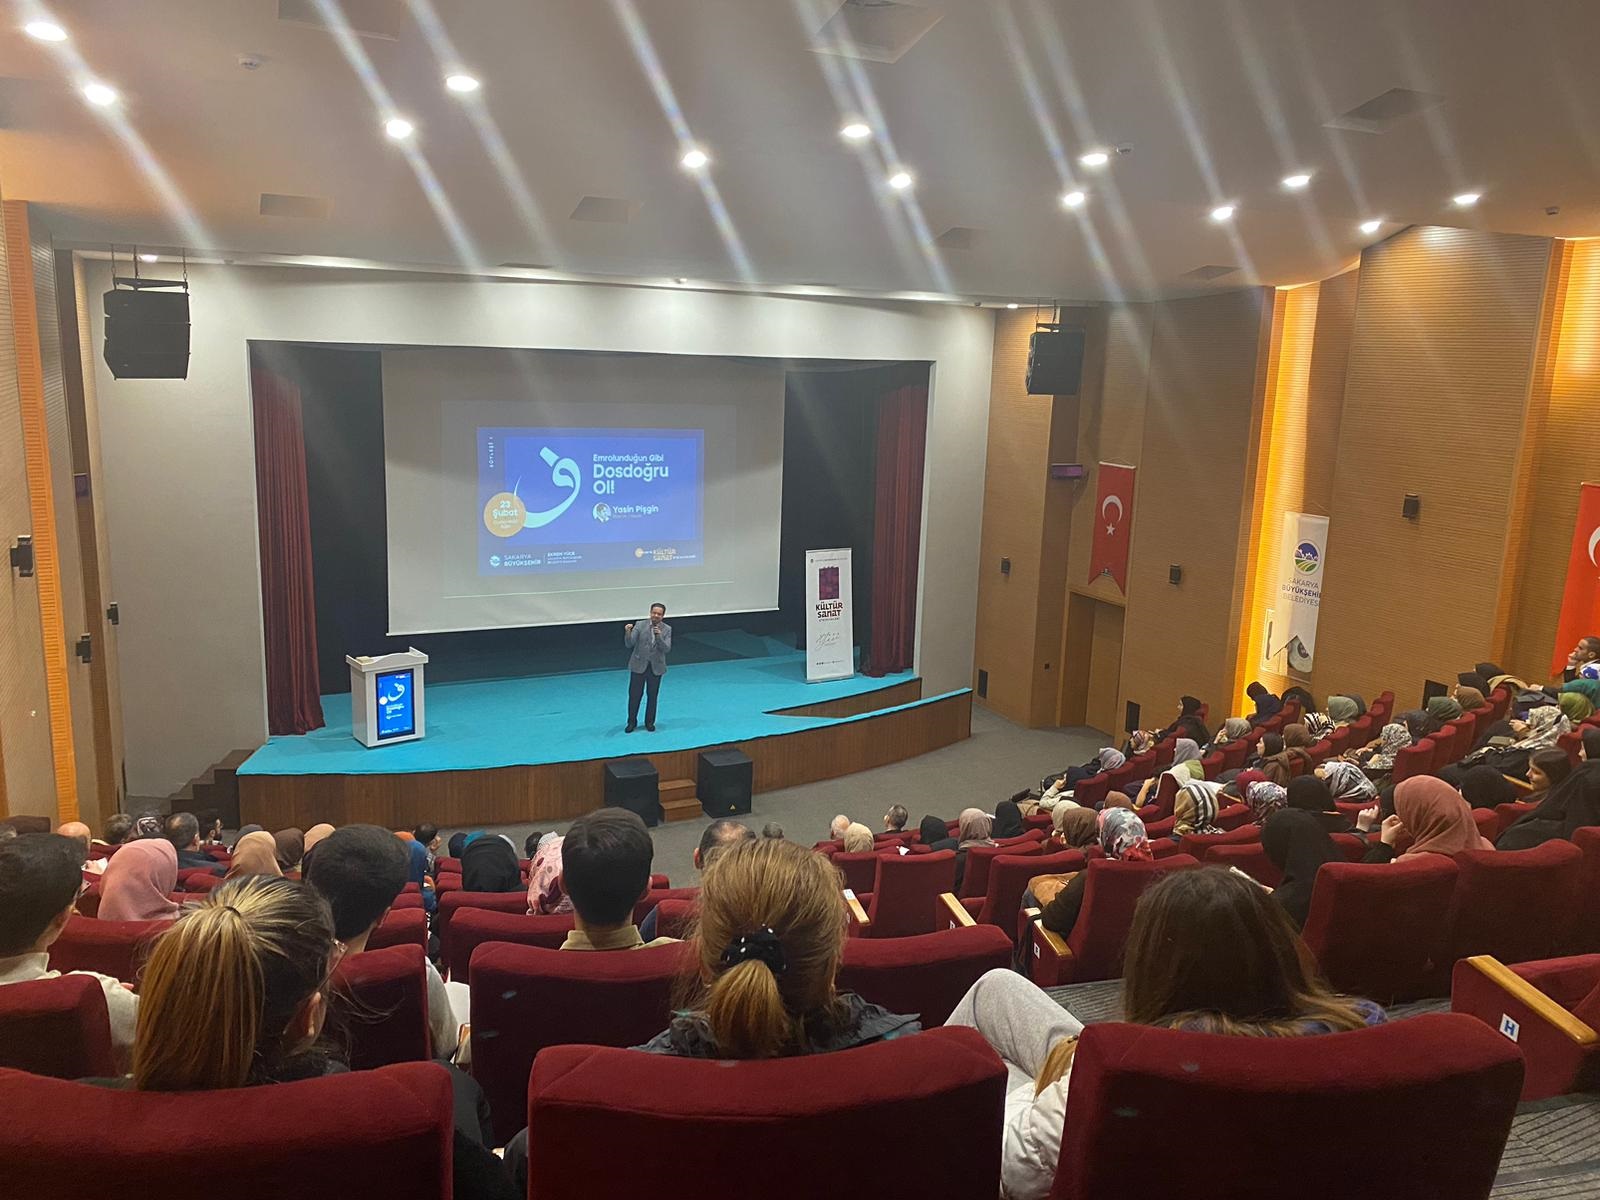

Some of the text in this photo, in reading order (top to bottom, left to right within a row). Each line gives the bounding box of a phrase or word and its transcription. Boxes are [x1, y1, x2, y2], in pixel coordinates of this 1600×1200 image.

[593, 453, 664, 464] Emrolunduğun Gibi
[593, 462, 669, 482] Dosdoğru
[593, 479, 615, 495] Ol!
[492, 508, 518, 519] Şubat
[612, 505, 659, 515] Yasin Pişgin
[1288, 577, 1319, 589] SAKARYA
[815, 601, 843, 611] KÜLTÜR
[1504, 1020, 1515, 1036] H
